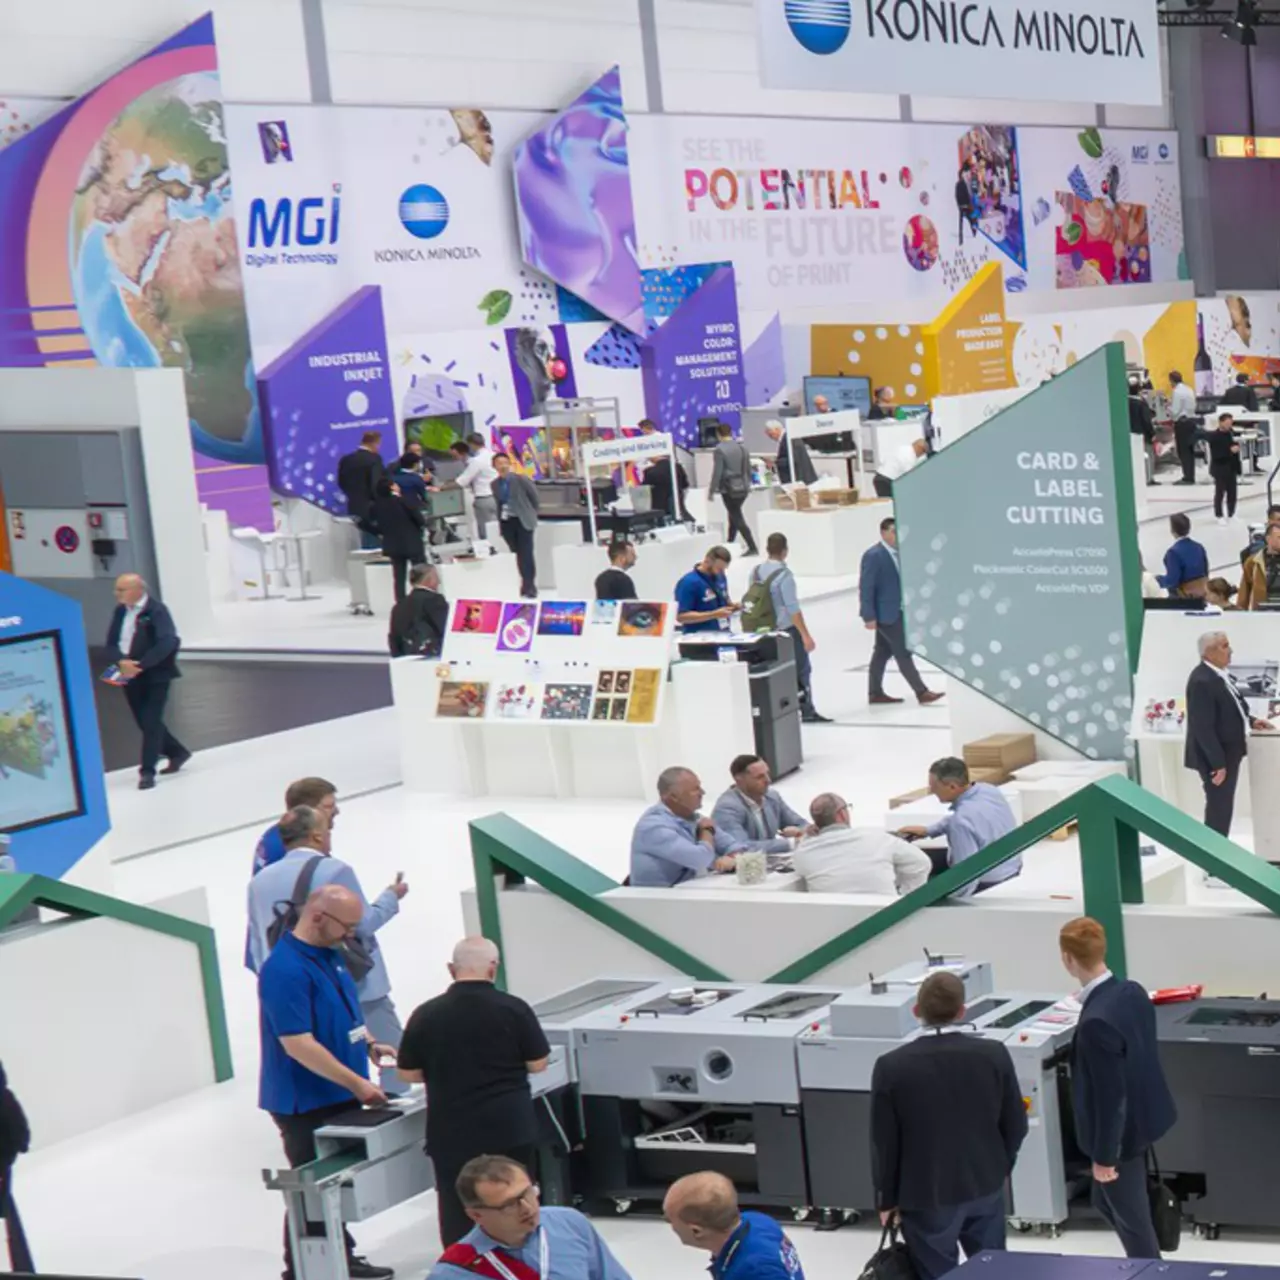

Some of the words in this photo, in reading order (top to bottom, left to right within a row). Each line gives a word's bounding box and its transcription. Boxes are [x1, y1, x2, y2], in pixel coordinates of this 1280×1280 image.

[867, 0, 1005, 48] KONICA
[1014, 9, 1144, 58] MINOLTA
[683, 137, 722, 162] SEE
[724, 137, 765, 162] THE
[684, 167, 880, 212] POTENTIAL
[716, 218, 759, 243] THE
[765, 214, 899, 258] FUTURE
[246, 253, 278, 268] Digital
[281, 252, 339, 266] Technology
[374, 246, 424, 262] KONICA
[427, 246, 481, 261] MINOLTA
[796, 263, 852, 287] PRINT
[308, 351, 382, 368] INDUSTRIAL
[675, 351, 737, 366] MANAGEMENT
[343, 366, 384, 381] INKJET
[690, 365, 739, 378] SOLUTIONS
[1016, 451, 1078, 470] CARD
[1083, 451, 1100, 470] &
[1034, 479, 1103, 497] LABEL
[1006, 506, 1104, 525] CUTTING
[1013, 547, 1074, 557] AccurioPress
